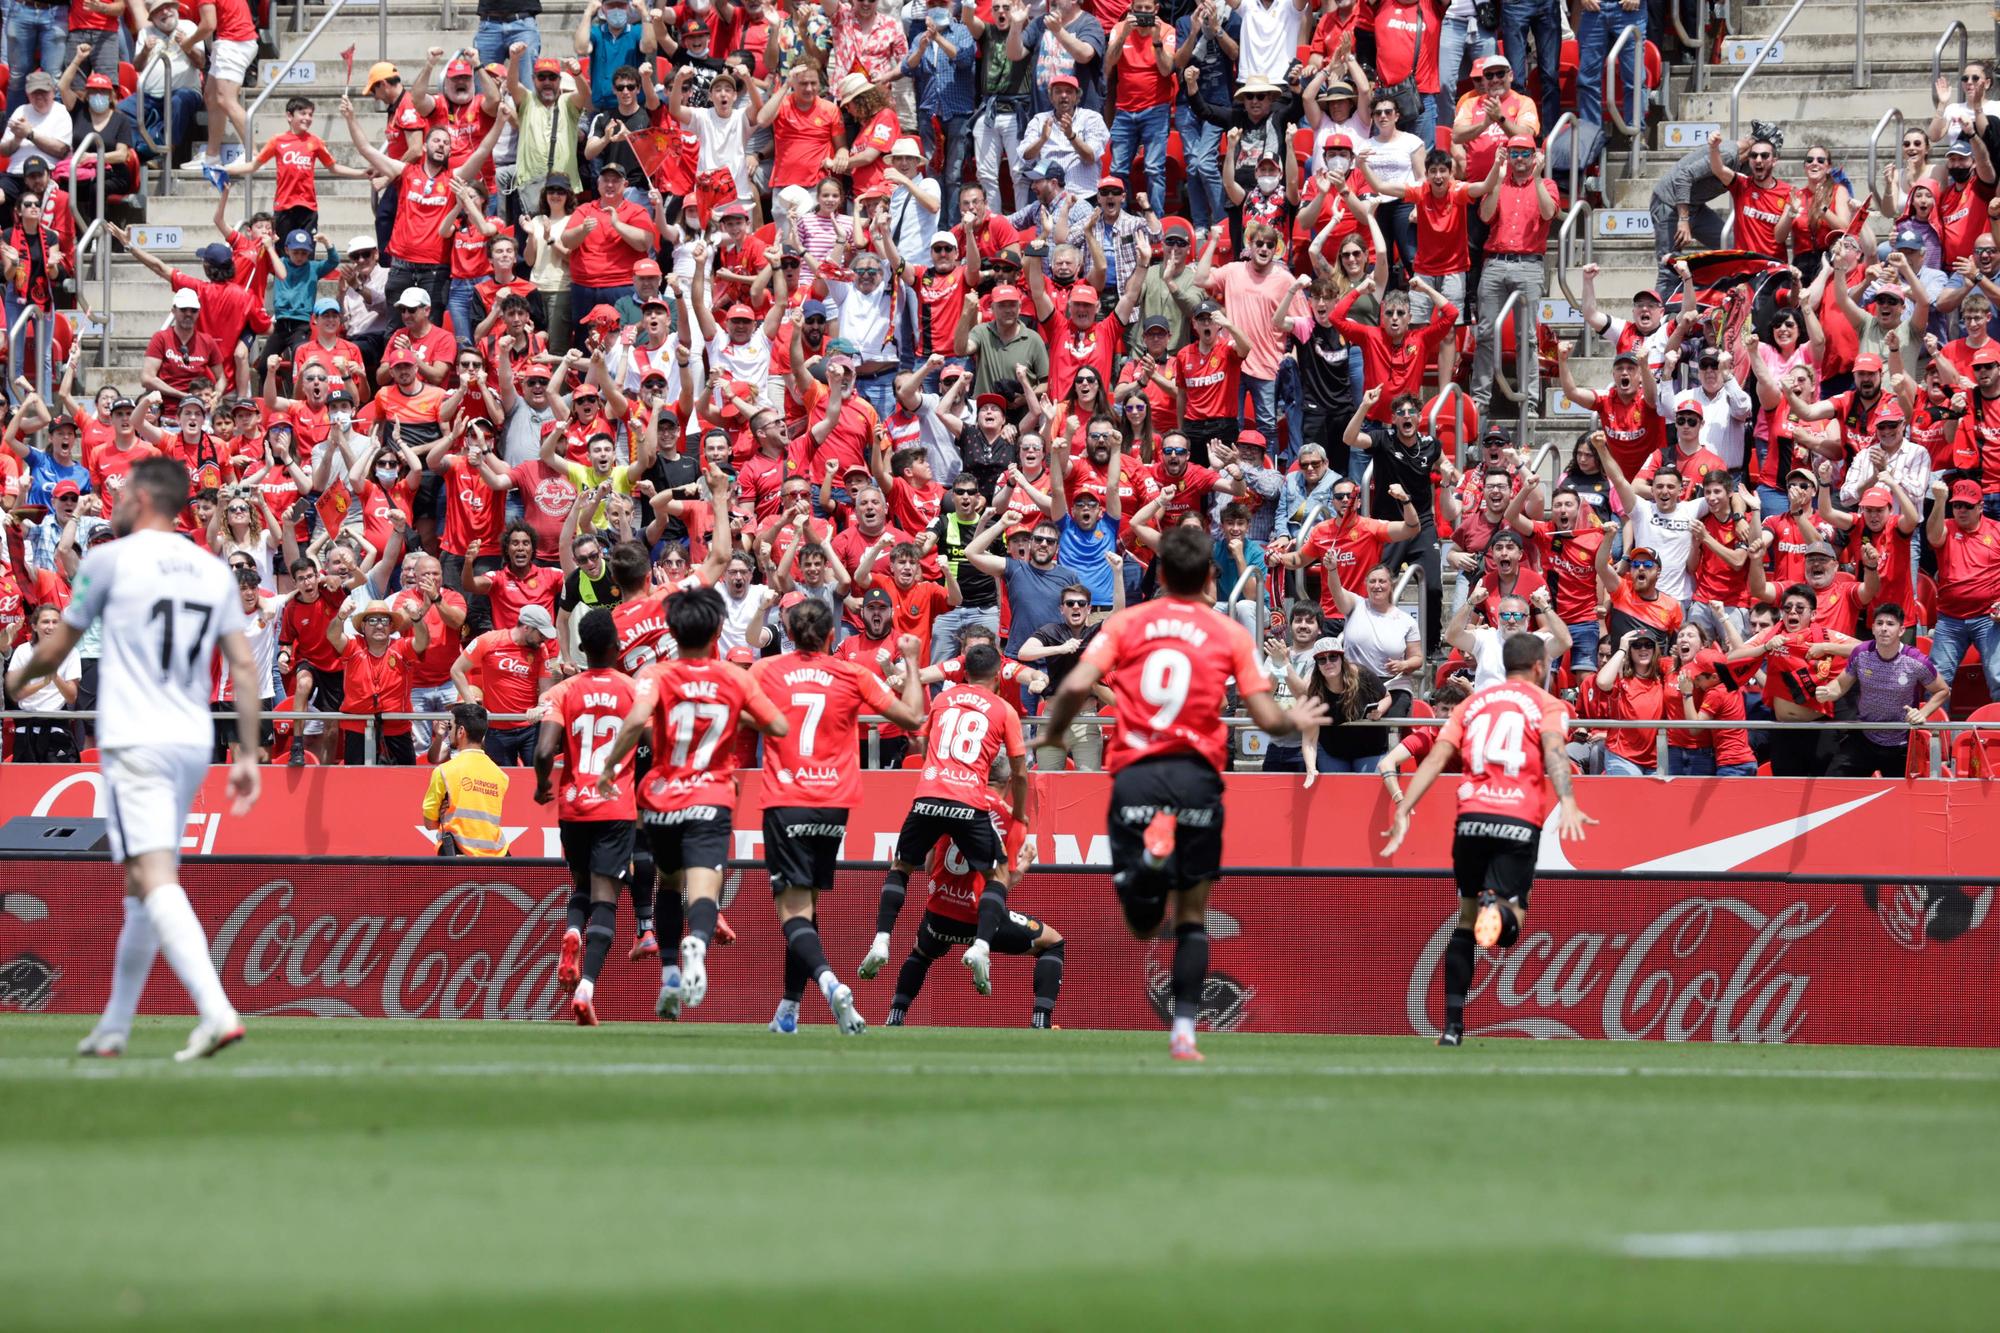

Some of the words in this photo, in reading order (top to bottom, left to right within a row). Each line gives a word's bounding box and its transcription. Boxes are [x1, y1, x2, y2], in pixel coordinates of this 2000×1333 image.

[289, 68, 294, 78] F
[298, 68, 310, 78] 12
[1694, 131, 1700, 141] F
[227, 150, 233, 160] F
[1626, 218, 1632, 228] F
[1637, 218, 1649, 228] 10
[1743, 206, 1781, 224] BETFRE
[156, 233, 162, 243] F
[165, 233, 177, 243] 10
[1568, 308, 1574, 317] F
[151, 598, 213, 686] 17
[784, 668, 834, 687] MURIQI
[681, 681, 720, 699] TAKE
[1140, 648, 1192, 731] 9
[583, 692, 618, 709] BABA
[947, 693, 992, 713] J.COSTA
[791, 692, 827, 757] 7
[572, 713, 626, 776] 12
[669, 701, 730, 771] 17
[937, 707, 989, 765] 18
[1466, 711, 1527, 778] 14
[795, 767, 840, 780] ALUA
[939, 767, 980, 785] ALUA
[1475, 783, 1525, 799] ALUA
[913, 801, 975, 820] SPECIALIZED
[938, 883, 977, 902] ALUA
[1009, 911, 1028, 926] 8
[210, 879, 572, 1020] Coca-Cola
[1406, 896, 1836, 1044] Coca-Cola
